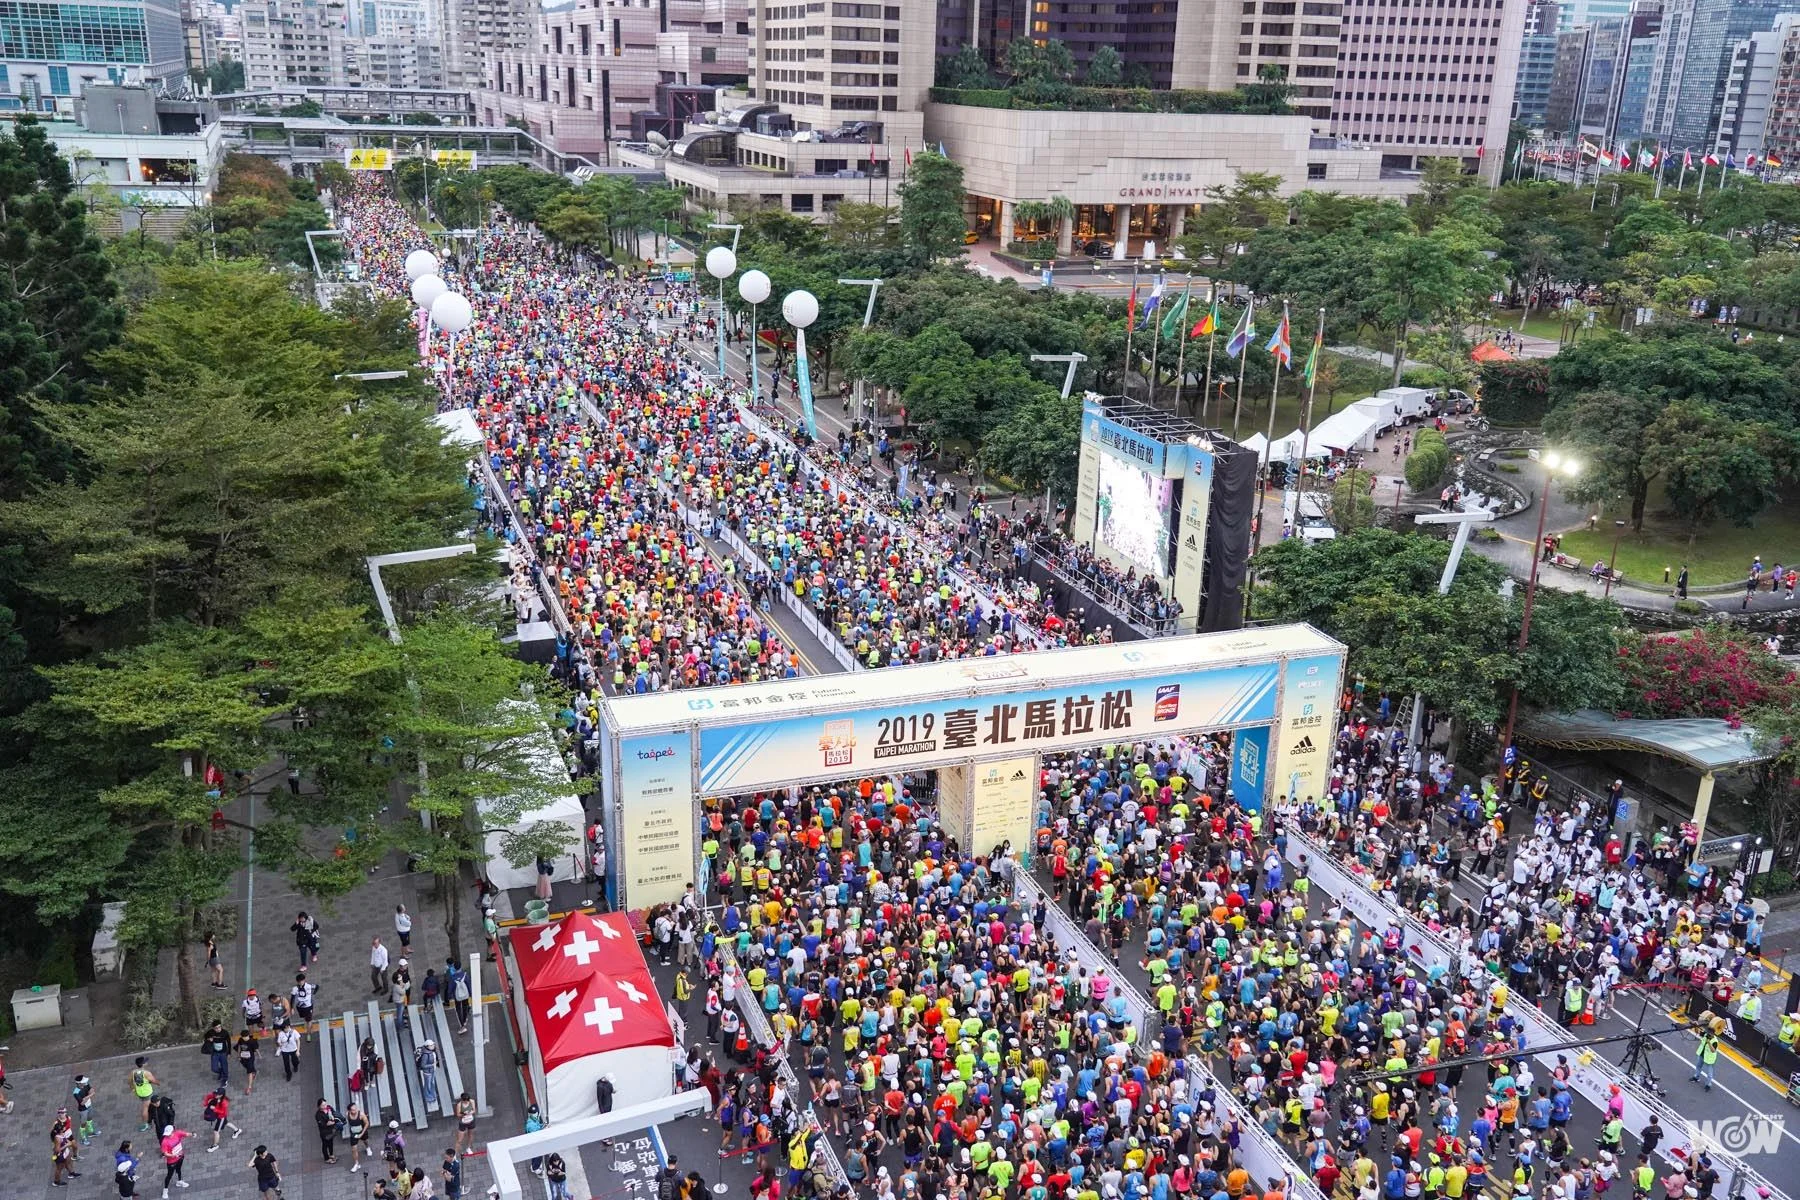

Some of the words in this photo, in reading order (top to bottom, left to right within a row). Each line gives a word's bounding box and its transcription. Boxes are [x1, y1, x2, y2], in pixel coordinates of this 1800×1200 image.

[1119, 188, 1161, 197] GRAND
[1169, 188, 1208, 197] HYATT
[1114, 431, 1154, 465] 臺北馬拉松
[1157, 686, 1176, 694] IAAF
[719, 692, 808, 708] 富邦金控
[876, 712, 936, 746] 2019
[943, 689, 1133, 750] 臺北馬拉松
[875, 744, 897, 758] TAIPEI
[898, 741, 935, 756] MARATHON
[1290, 746, 1317, 755] adidas
[1505, 747, 1513, 758] P
[828, 755, 849, 764] 2019
